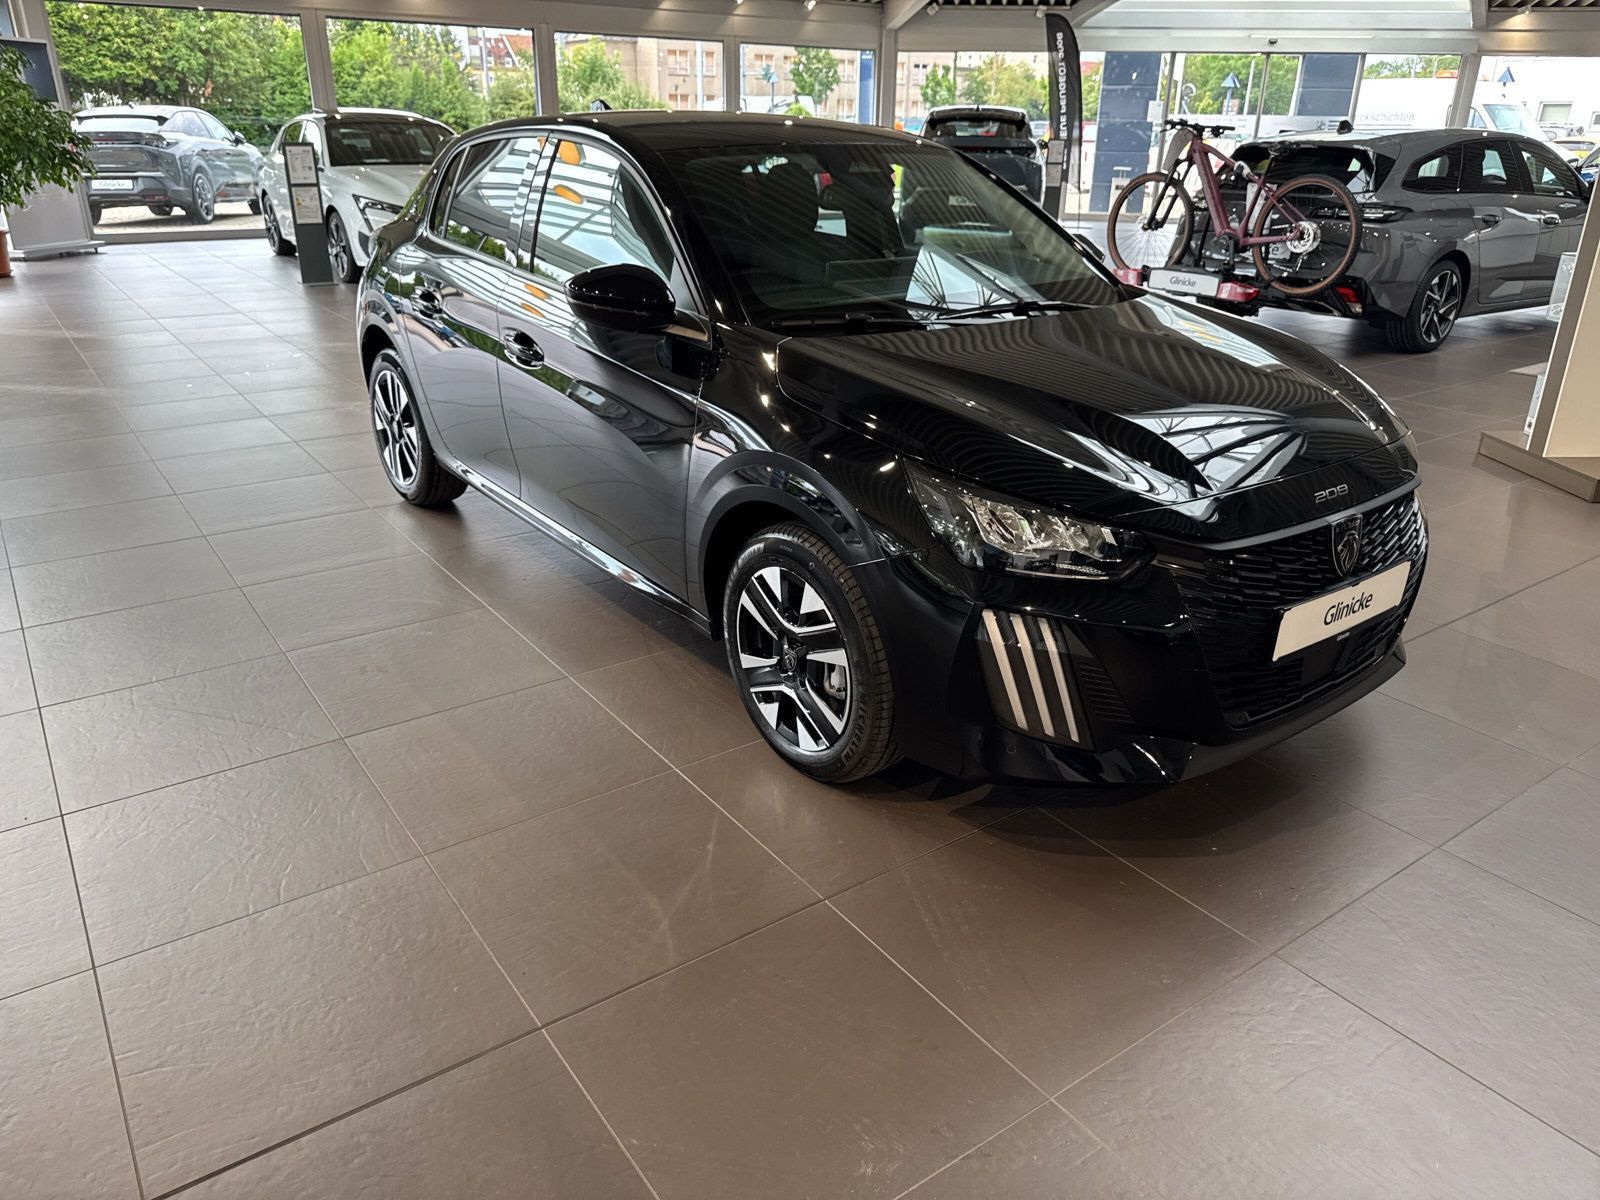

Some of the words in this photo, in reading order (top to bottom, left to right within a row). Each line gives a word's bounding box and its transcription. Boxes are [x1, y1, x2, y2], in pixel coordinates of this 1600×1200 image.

[1356, 111, 1415, 122] ckschichten
[1170, 276, 1196, 287] Glinicke
[1314, 483, 1349, 504] 208
[1323, 591, 1374, 626] Glinicke
[844, 695, 867, 762] MICHELIN
